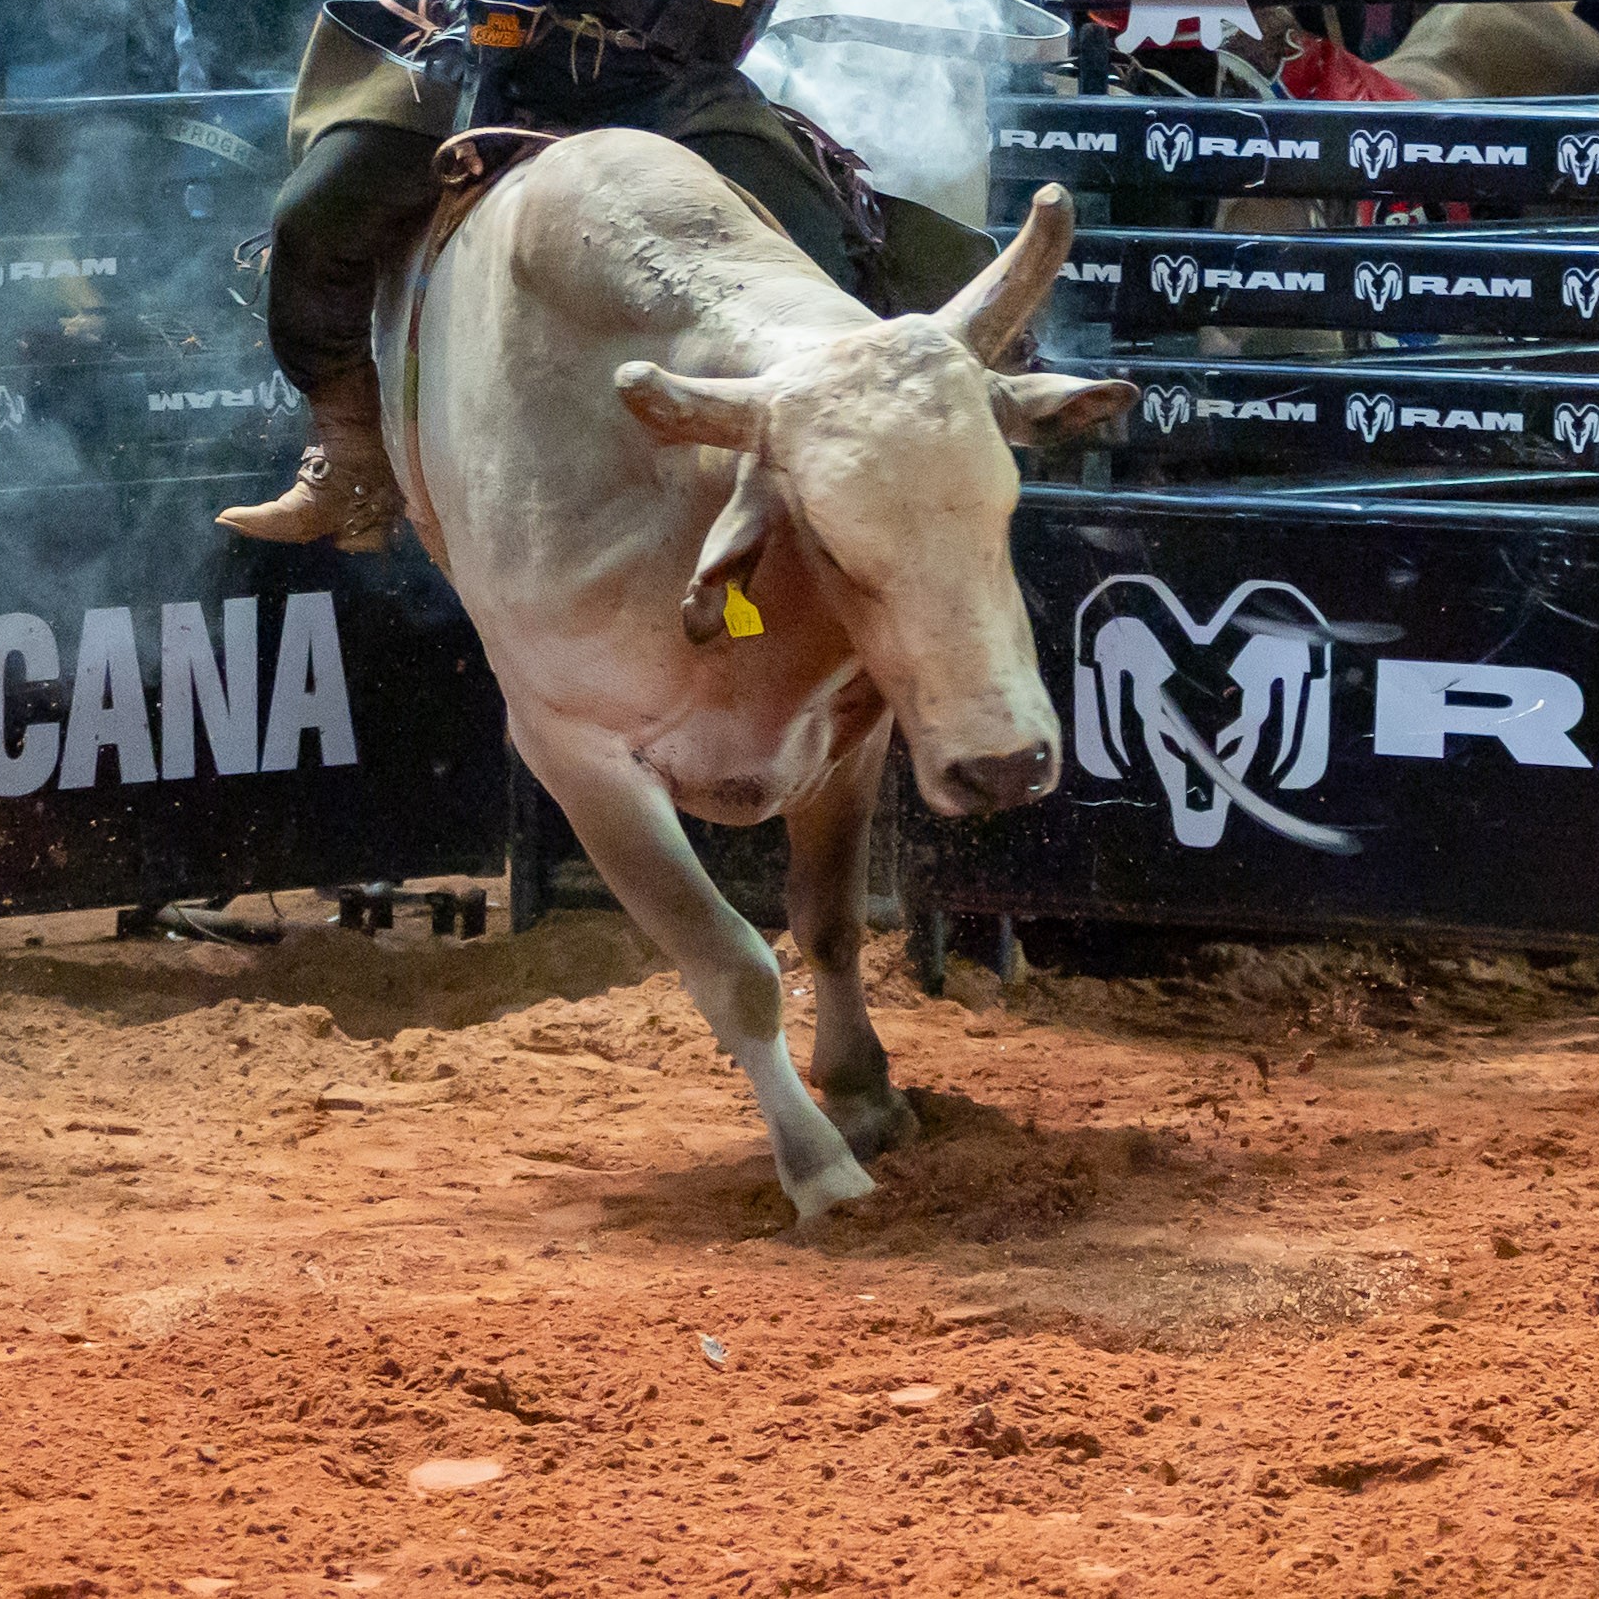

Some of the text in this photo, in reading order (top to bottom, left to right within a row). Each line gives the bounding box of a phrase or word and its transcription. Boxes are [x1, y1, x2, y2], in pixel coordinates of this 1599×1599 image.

[1000, 129, 1118, 152] RAM
[1198, 136, 1320, 161] RAM
[1404, 141, 1528, 166] RAM
[10, 257, 117, 279] RAM
[1054, 262, 1123, 284] AM
[1203, 267, 1326, 292] RAM
[1408, 274, 1533, 299] RAM
[1197, 399, 1317, 424] RAM
[1401, 406, 1524, 432] RAM
